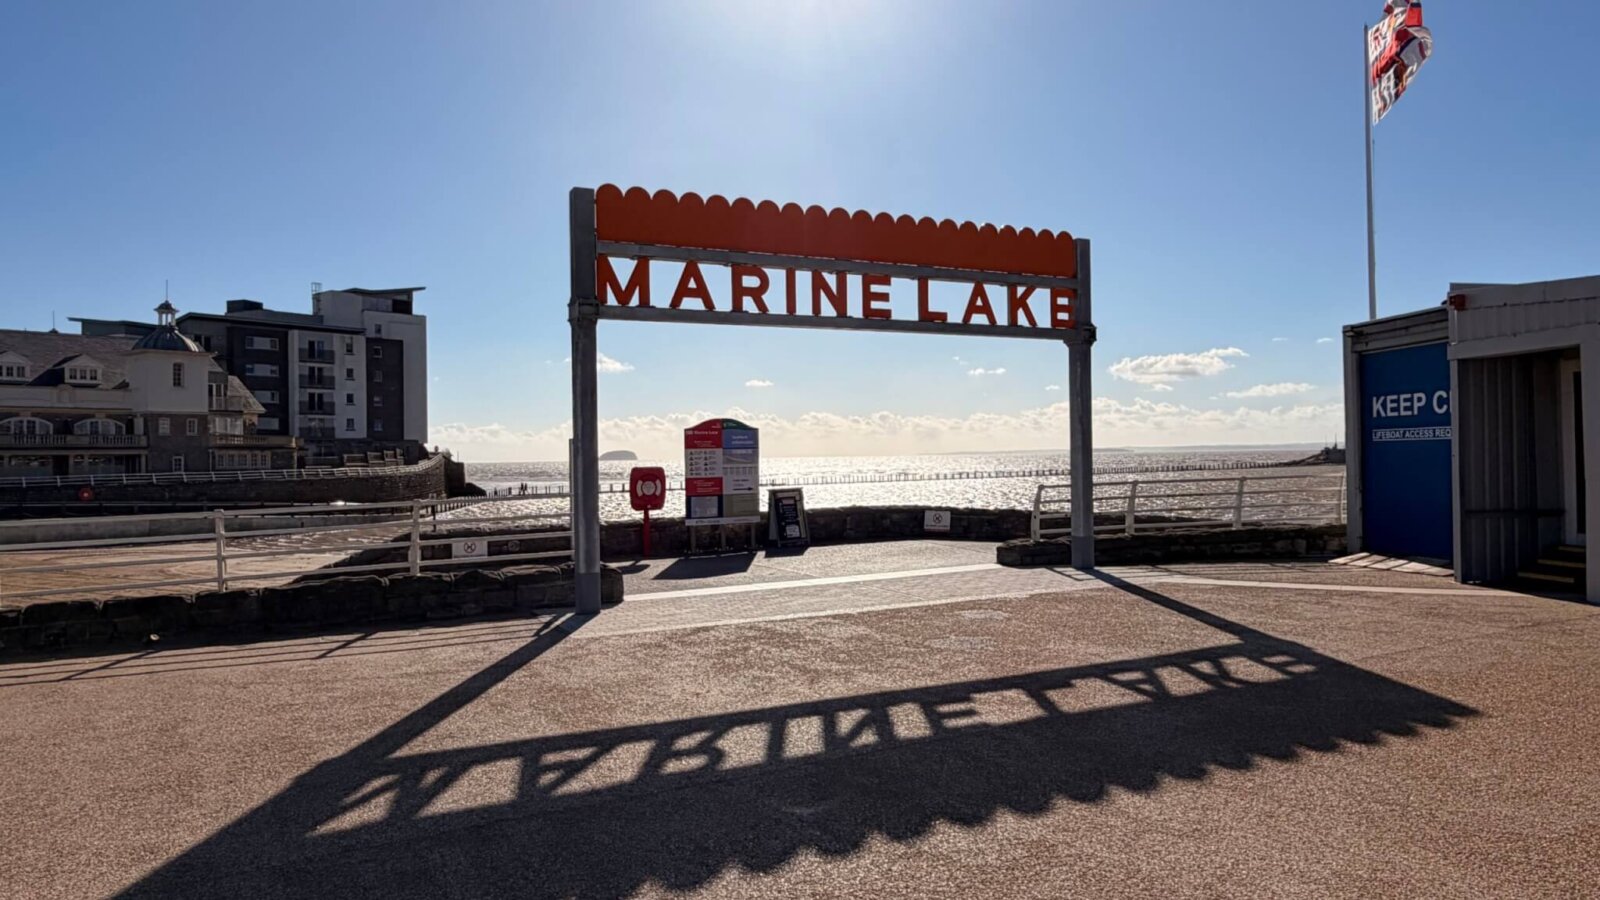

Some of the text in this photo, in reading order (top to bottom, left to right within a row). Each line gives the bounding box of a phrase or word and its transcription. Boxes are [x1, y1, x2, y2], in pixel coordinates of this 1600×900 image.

[597, 253, 1076, 329] MARINE LAKE
[1372, 390, 1452, 418] KEEP C
[1372, 430, 1404, 440] LIFEBOAT
[1405, 429, 1433, 438] ACCESS
